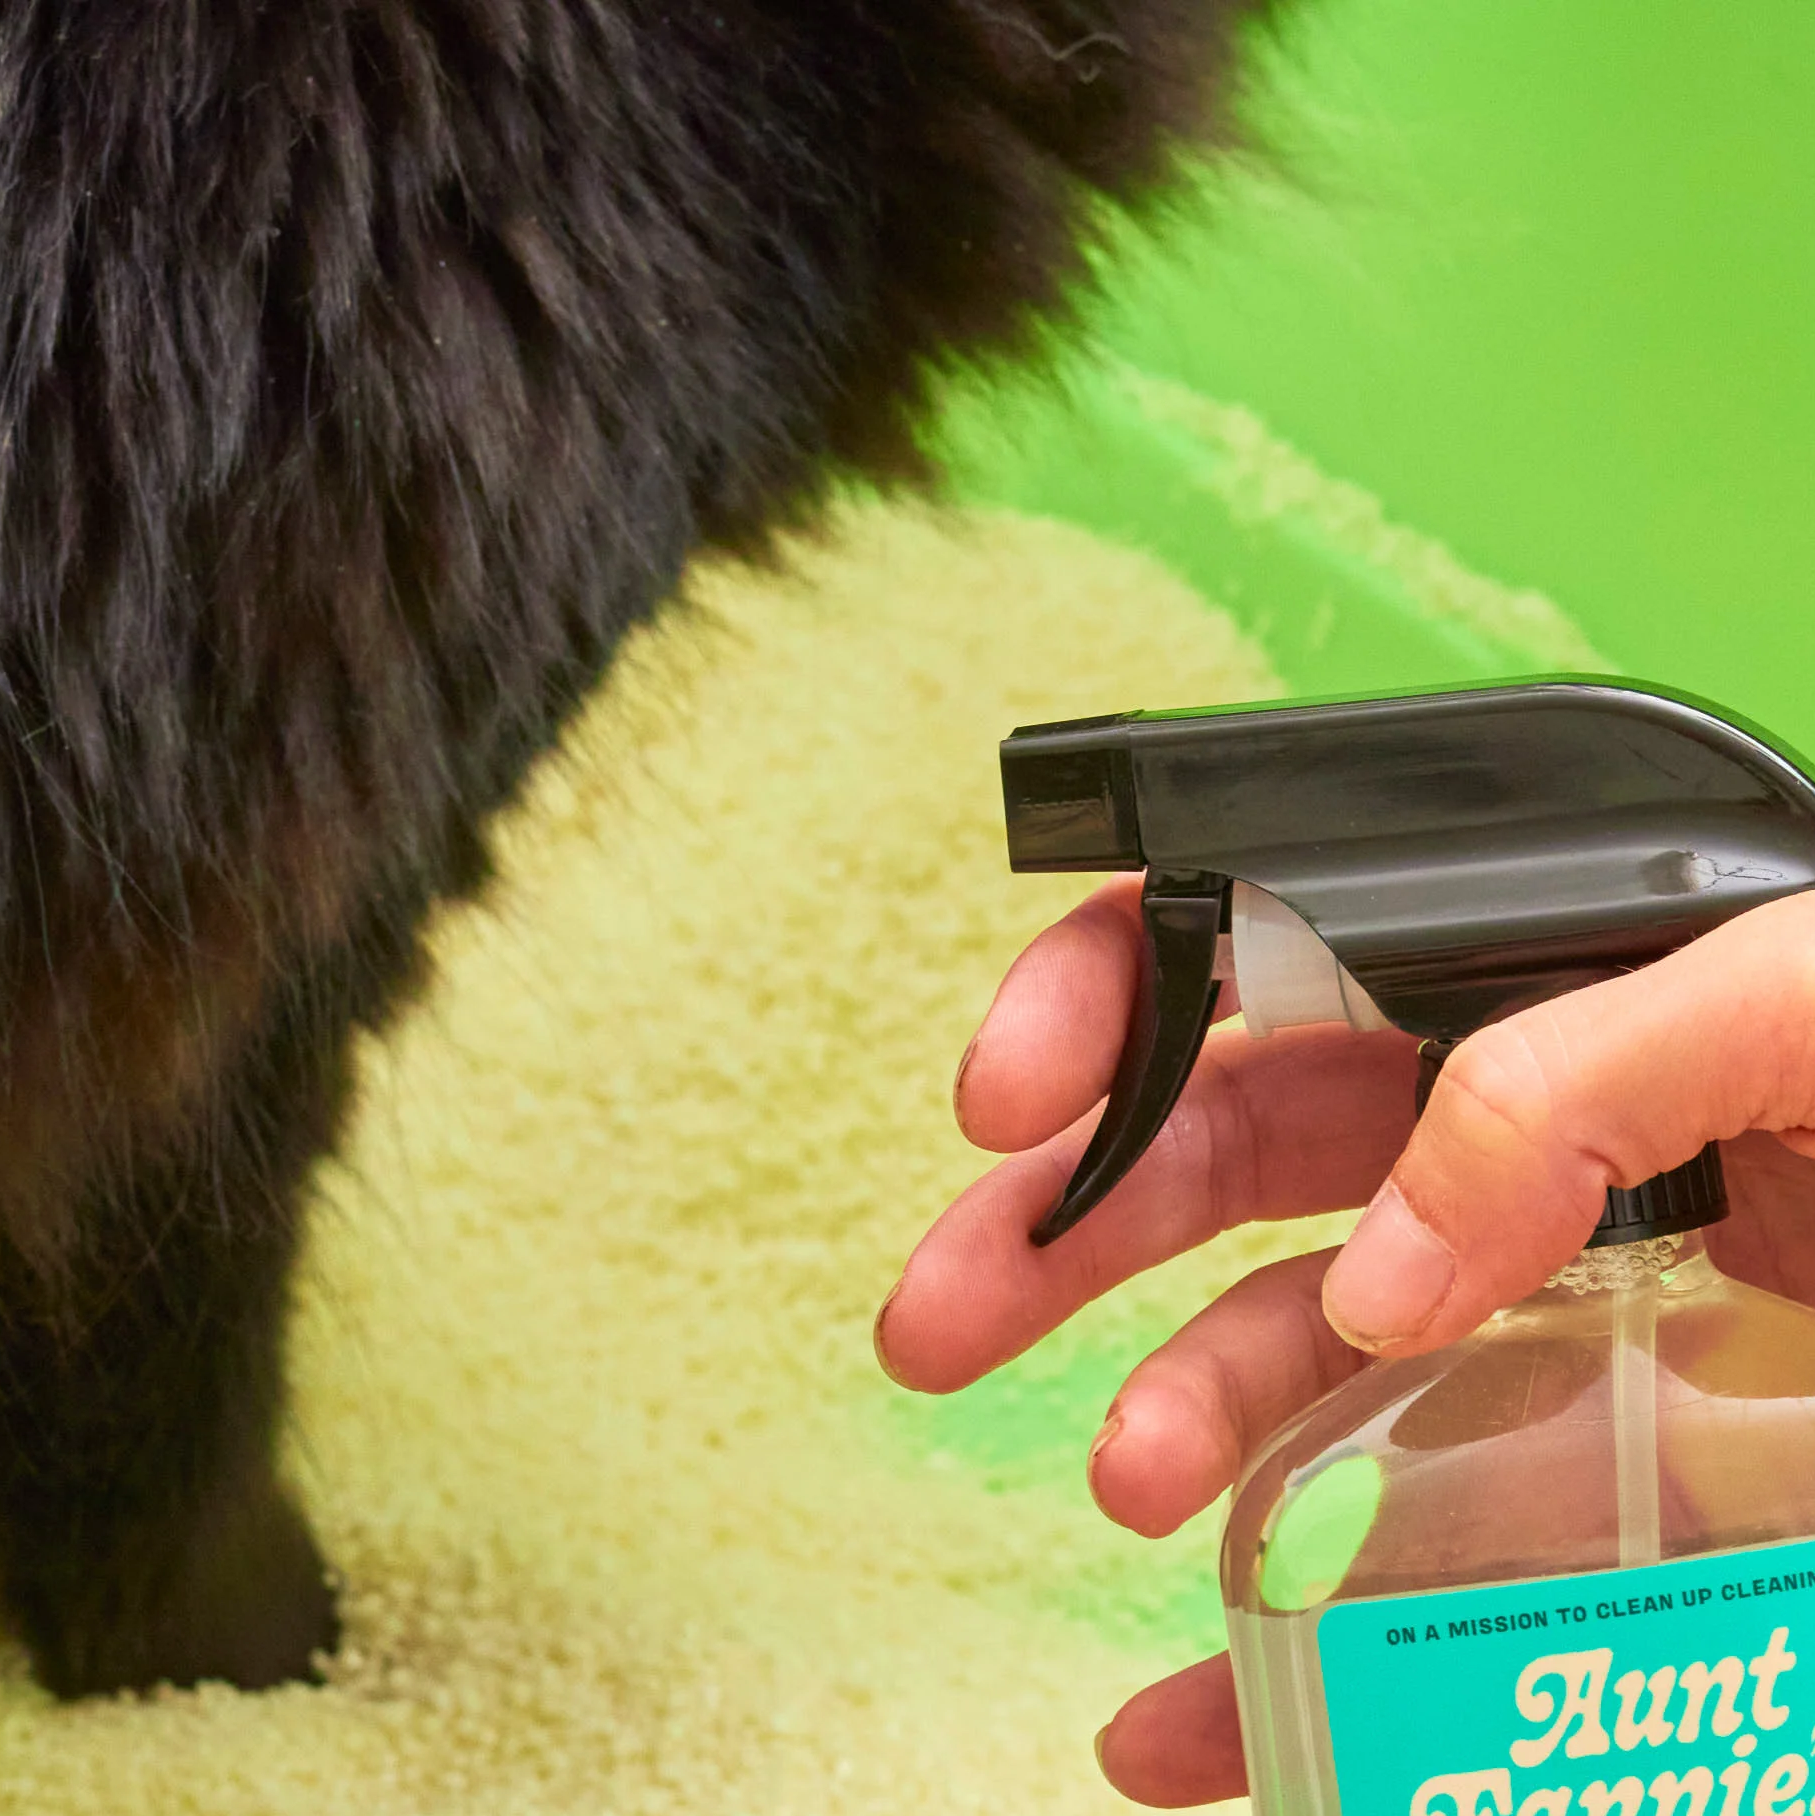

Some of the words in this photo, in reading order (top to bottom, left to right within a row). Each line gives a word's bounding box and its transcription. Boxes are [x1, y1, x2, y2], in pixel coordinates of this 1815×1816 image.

[1386, 1627, 1416, 1646] ON
[1425, 1624, 1440, 1641] A
[1448, 1610, 1548, 1638] MISSION
[1556, 1605, 1587, 1623] TO
[1596, 1593, 1673, 1620] CLEAN
[1682, 1588, 1712, 1607] UP
[1509, 1626, 1797, 1768] Aunt
